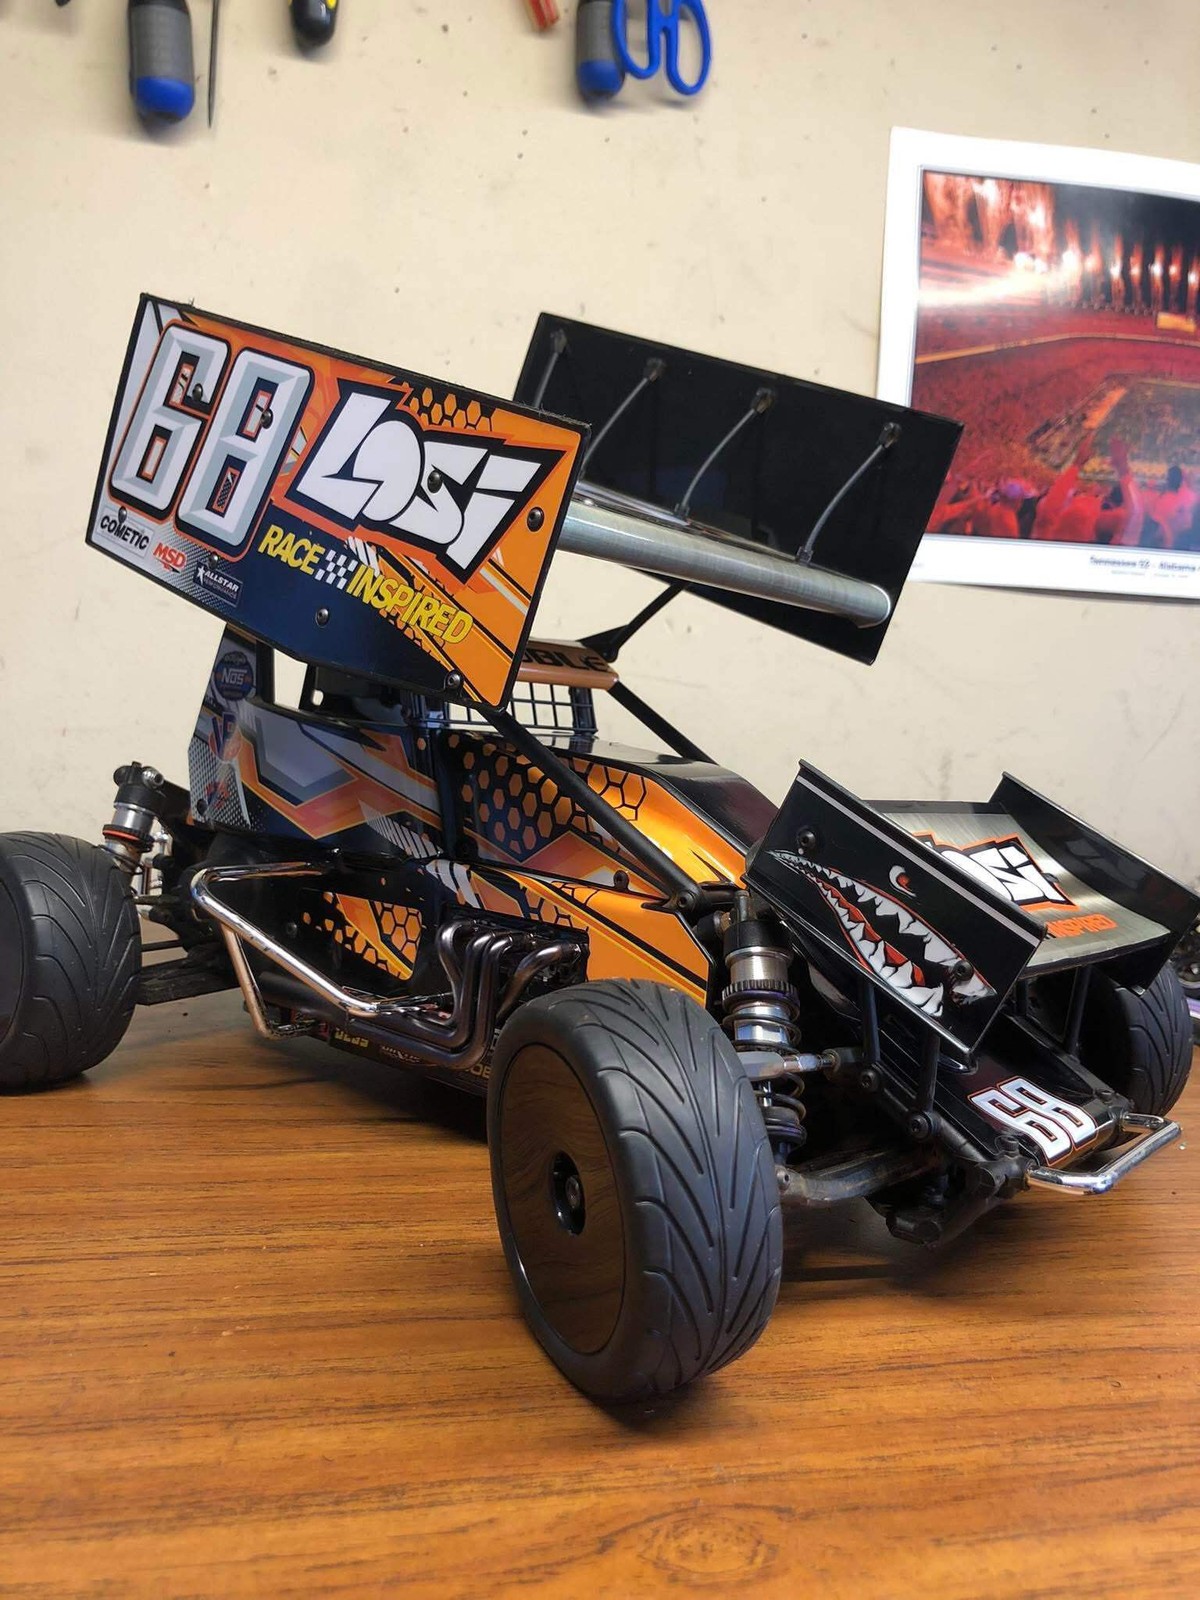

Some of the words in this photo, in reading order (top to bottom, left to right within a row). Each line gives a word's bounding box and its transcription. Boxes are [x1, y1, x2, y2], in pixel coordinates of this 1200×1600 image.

[110, 322, 313, 549] 68
[296, 392, 542, 570] LOSI
[100, 515, 150, 550] COMETIC
[152, 541, 187, 569] MSD
[204, 570, 240, 593] ALLSTAR
[257, 524, 326, 575] RACE
[346, 564, 474, 645] INSPIRED
[221, 667, 248, 686] NOS
[970, 1077, 1098, 1164] 68
